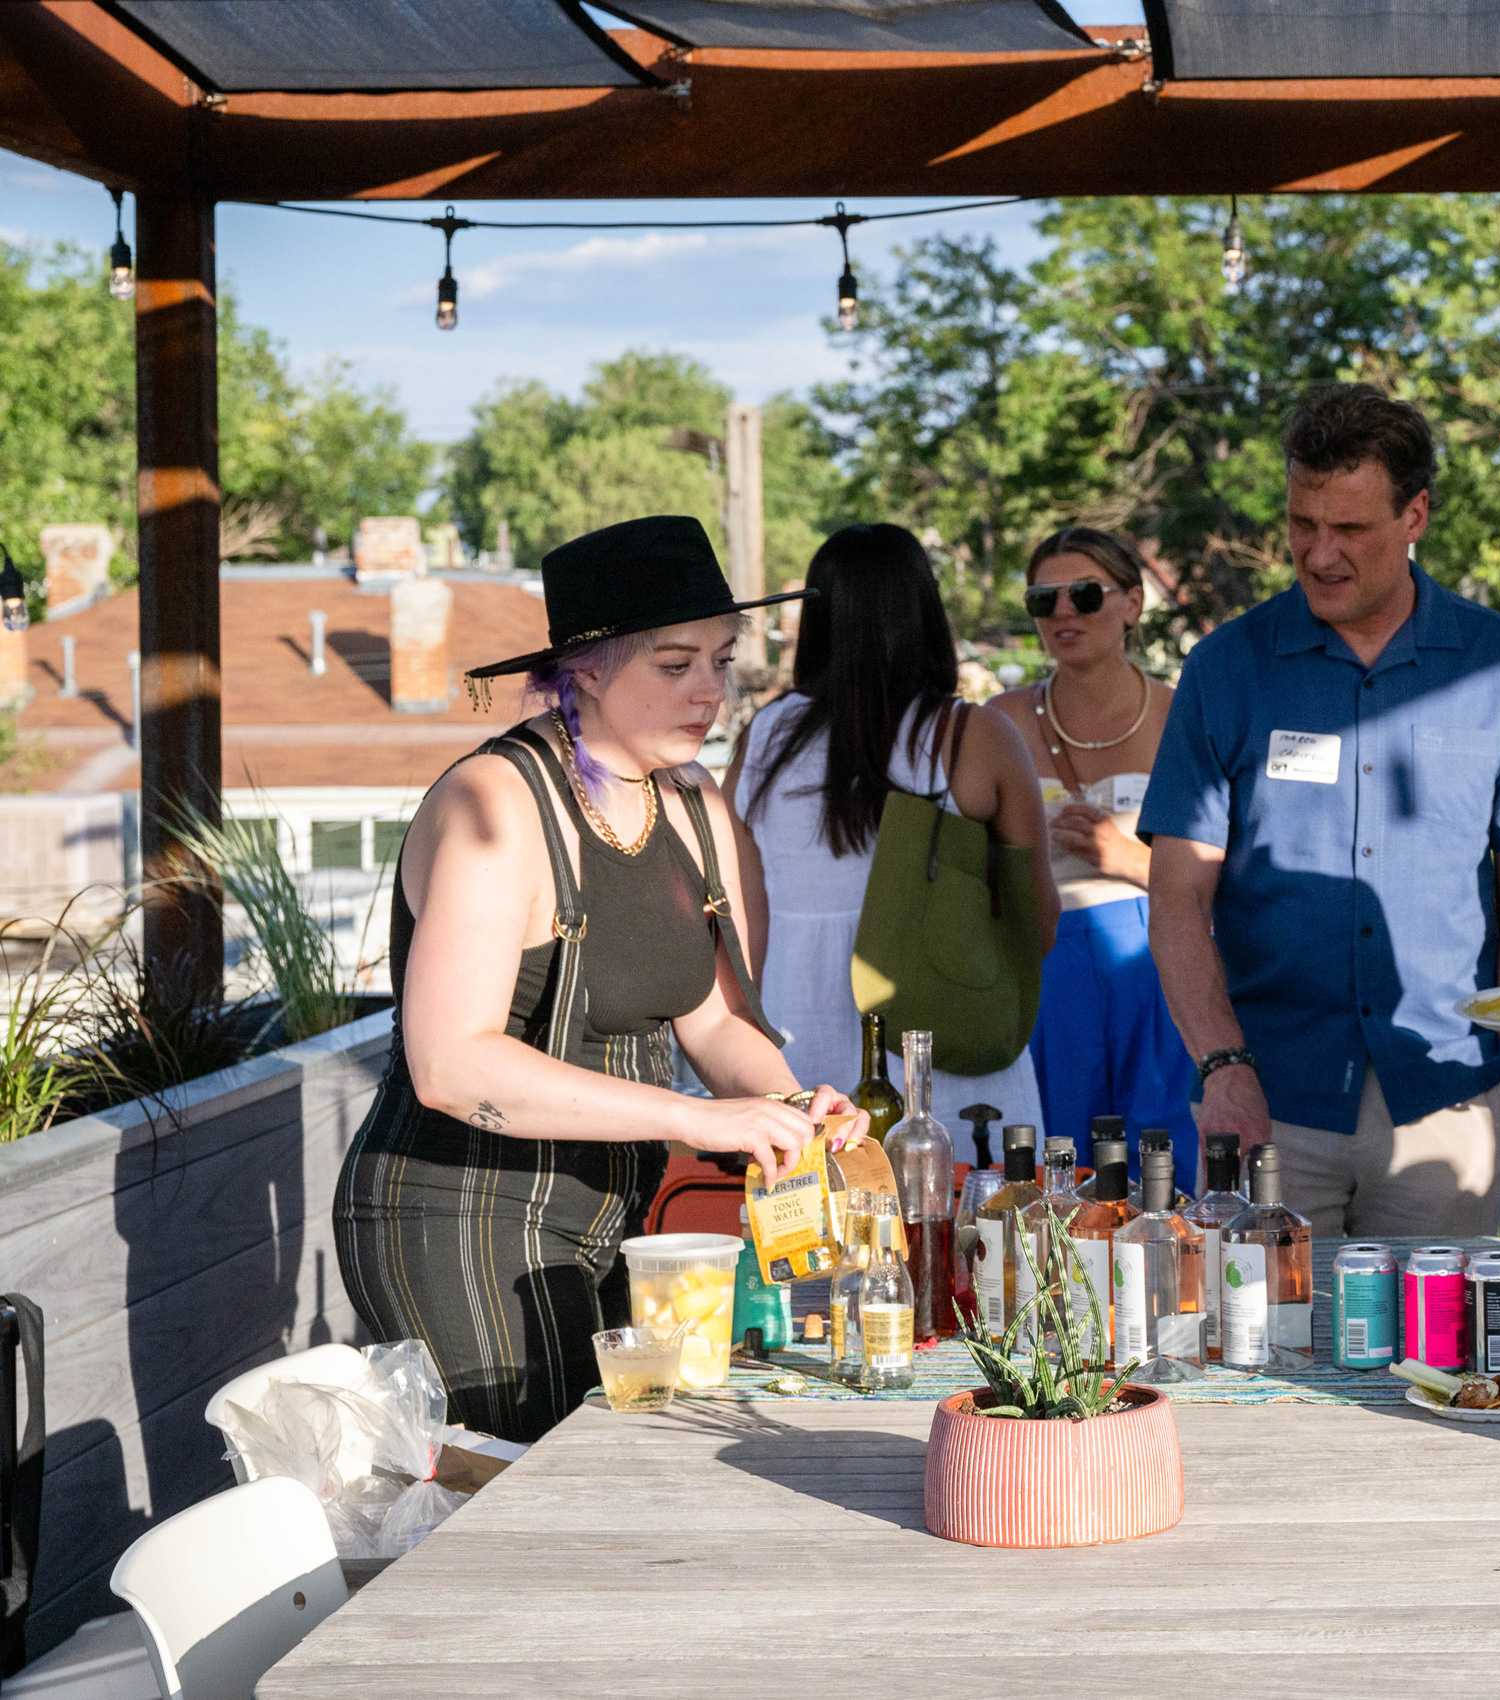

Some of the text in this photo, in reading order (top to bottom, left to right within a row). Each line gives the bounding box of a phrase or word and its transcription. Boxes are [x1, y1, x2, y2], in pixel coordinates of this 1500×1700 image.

[757, 1175, 814, 1198] FEER-TREE
[773, 1198, 802, 1213] TONIC
[773, 1208, 805, 1222] WATER
